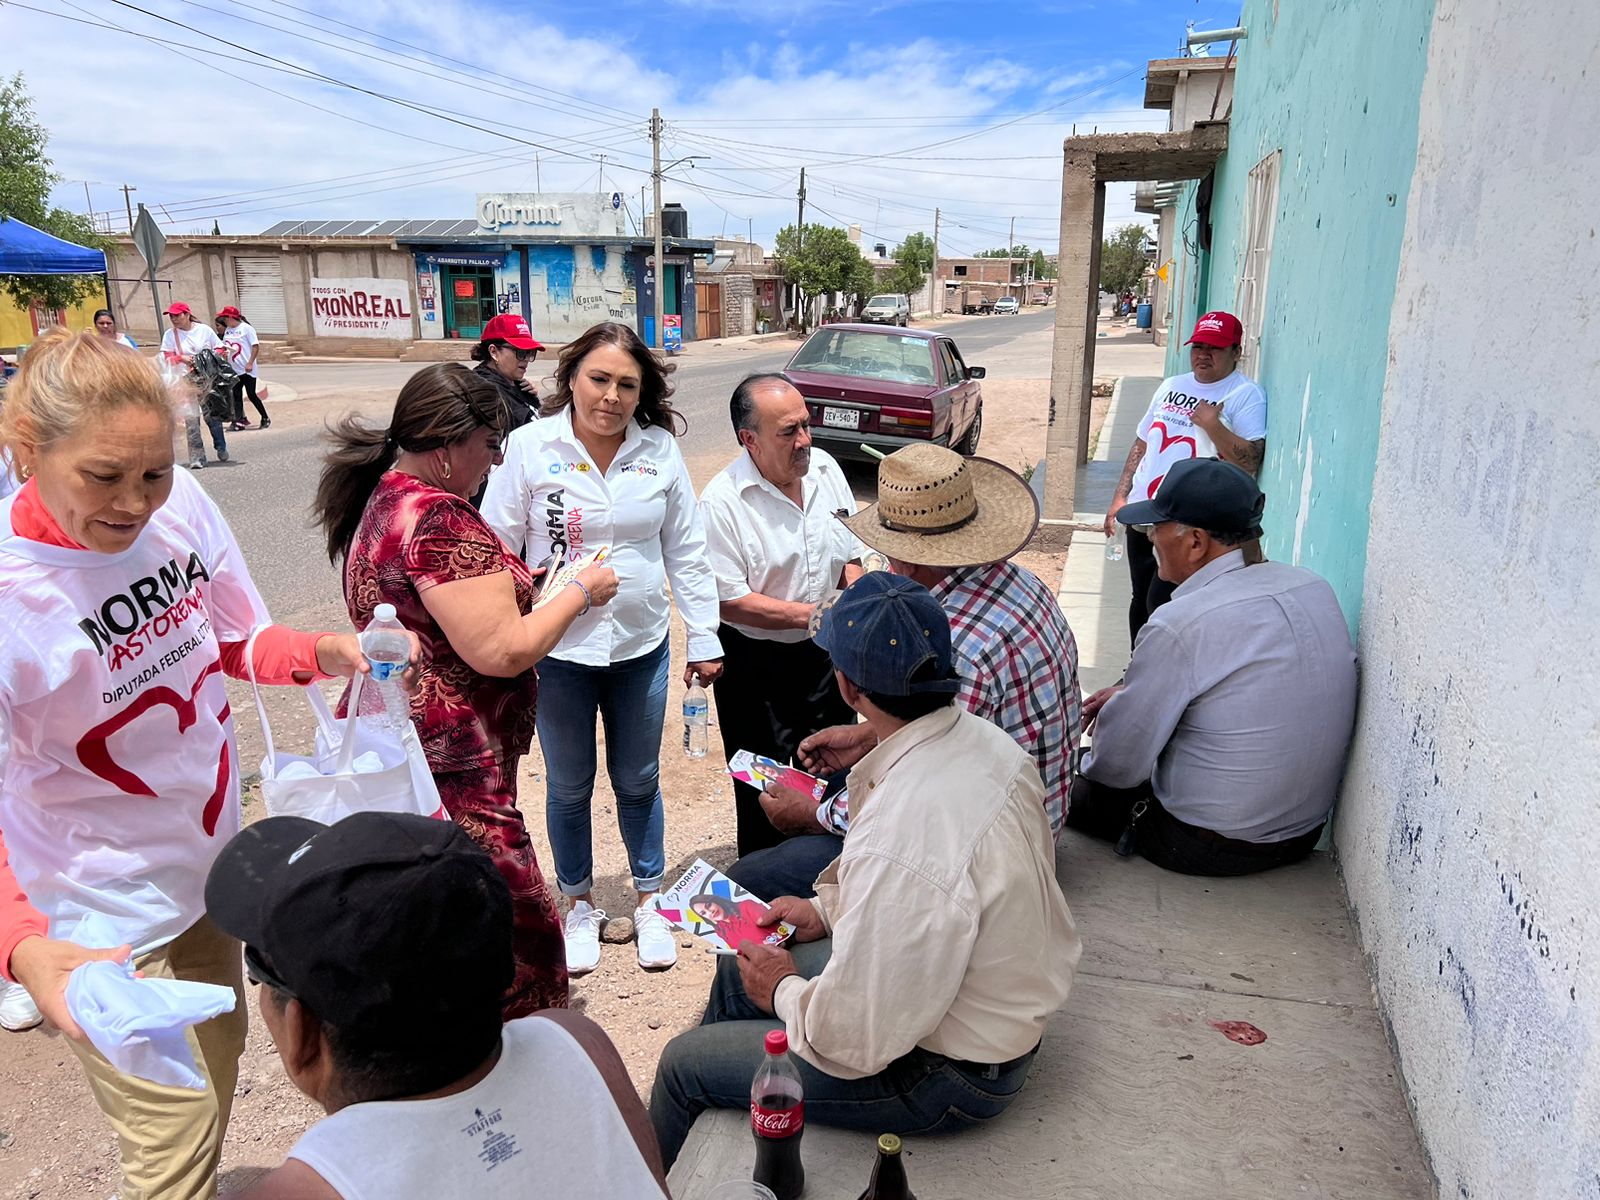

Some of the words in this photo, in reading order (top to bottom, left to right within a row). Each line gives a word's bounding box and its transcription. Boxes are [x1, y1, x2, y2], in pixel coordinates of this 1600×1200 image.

[481, 199, 561, 232] Corona
[567, 507, 583, 562] STORENA
[78, 551, 210, 656] NORMA
[102, 664, 160, 704] DIPUTADA
[159, 634, 202, 672] FEDERAL
[674, 865, 702, 892] NORMA
